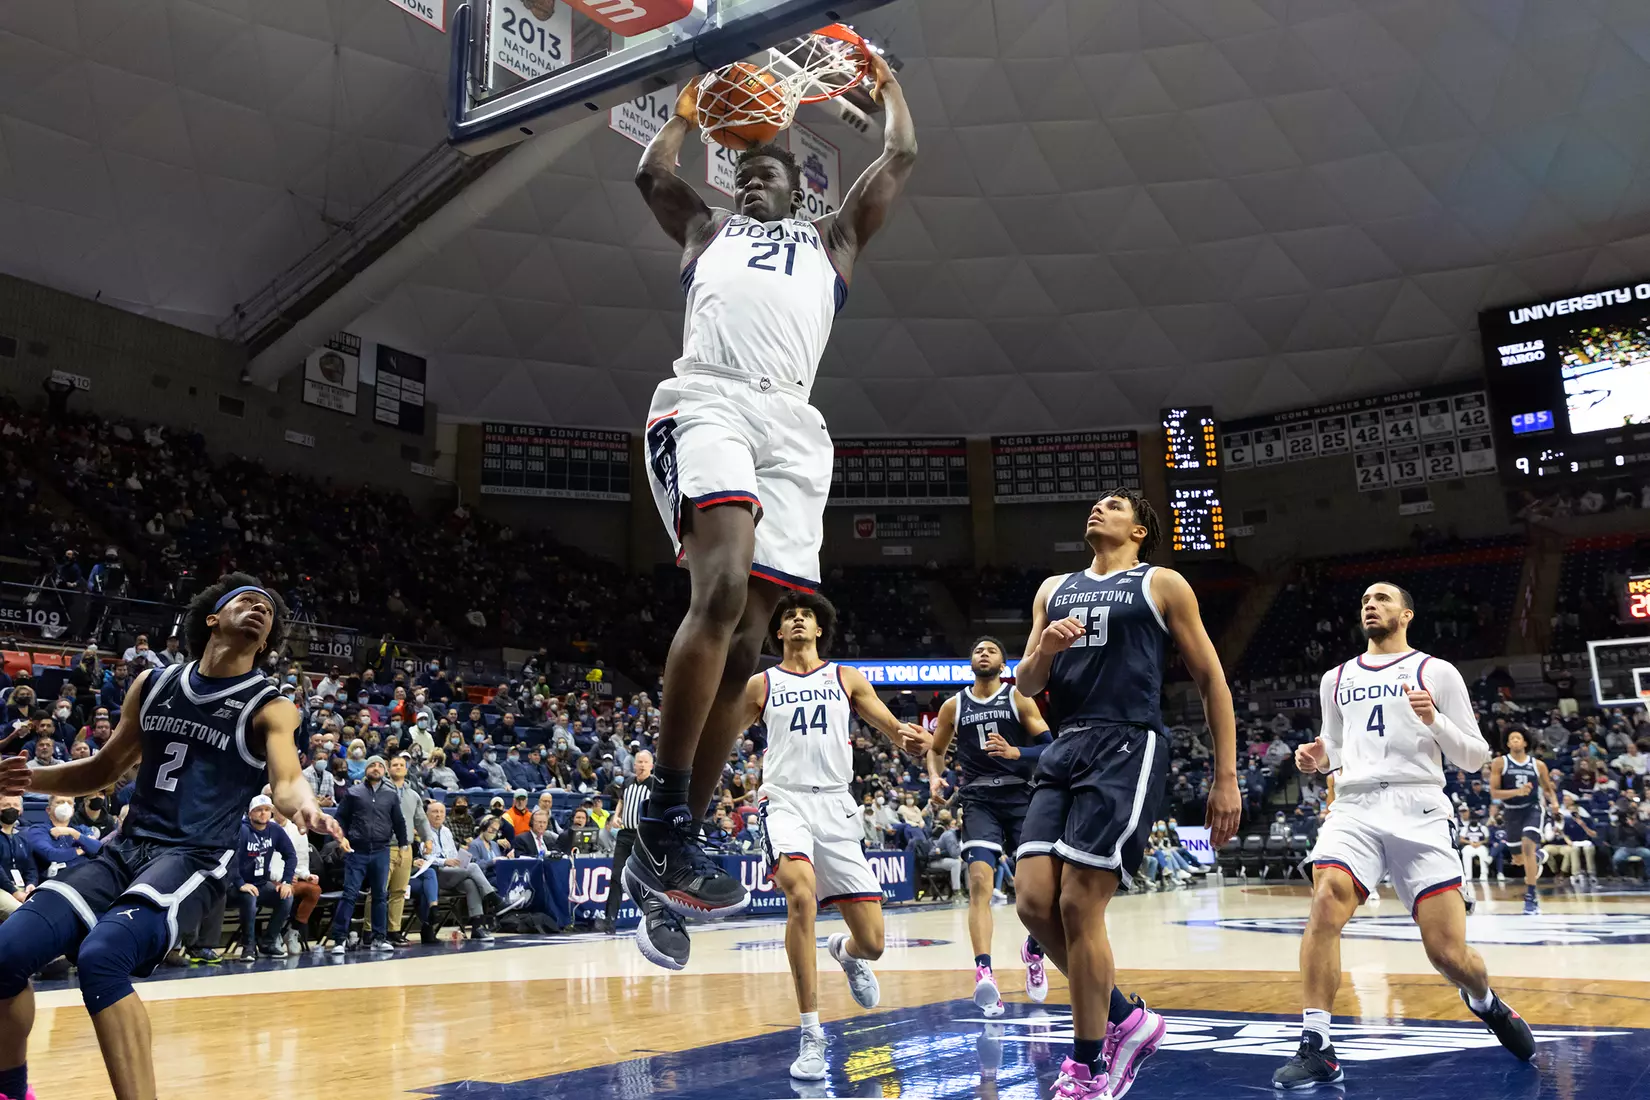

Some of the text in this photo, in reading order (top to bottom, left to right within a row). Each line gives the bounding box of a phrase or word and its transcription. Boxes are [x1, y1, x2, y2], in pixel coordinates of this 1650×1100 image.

[402, 0, 434, 19] ONS
[502, 7, 561, 60] 2013
[498, 51, 541, 77] CHAMP
[627, 95, 668, 123] 014
[618, 121, 652, 142] CHAMP
[747, 242, 796, 276] 21
[1509, 287, 1632, 324] UNIVERSITY
[1498, 339, 1545, 355] WELLS
[1501, 350, 1546, 366] FARGO
[1461, 410, 1486, 426] 42
[1511, 411, 1548, 427] CBS
[486, 425, 629, 441] BIG EAST CONFERENCE
[1357, 427, 1380, 443] 42
[1390, 421, 1414, 437] 44
[1000, 433, 1129, 446] NCAA CHAMPIONSHIP
[1290, 438, 1313, 453] 22
[1322, 432, 1346, 448] 25
[1232, 449, 1245, 462] C
[1265, 444, 1274, 457] 9
[1398, 463, 1416, 477] 13
[1430, 457, 1453, 472] 22
[1361, 467, 1384, 482] 24
[1055, 590, 1134, 608] GEORGETOWN
[1631, 594, 1650, 618] 2
[1, 608, 60, 626] SEC 109
[309, 642, 352, 656] SEC 109
[394, 658, 406, 668] SE
[885, 665, 918, 682] YOU
[919, 665, 950, 681] CAN
[772, 688, 841, 707] UCONN
[790, 704, 828, 736] 44
[961, 709, 1012, 726] GEORGETOWN
[1366, 704, 1386, 737] 4
[144, 714, 231, 751] GEORGETOWN
[155, 741, 189, 792] 2
[247, 837, 273, 851] UCNN
